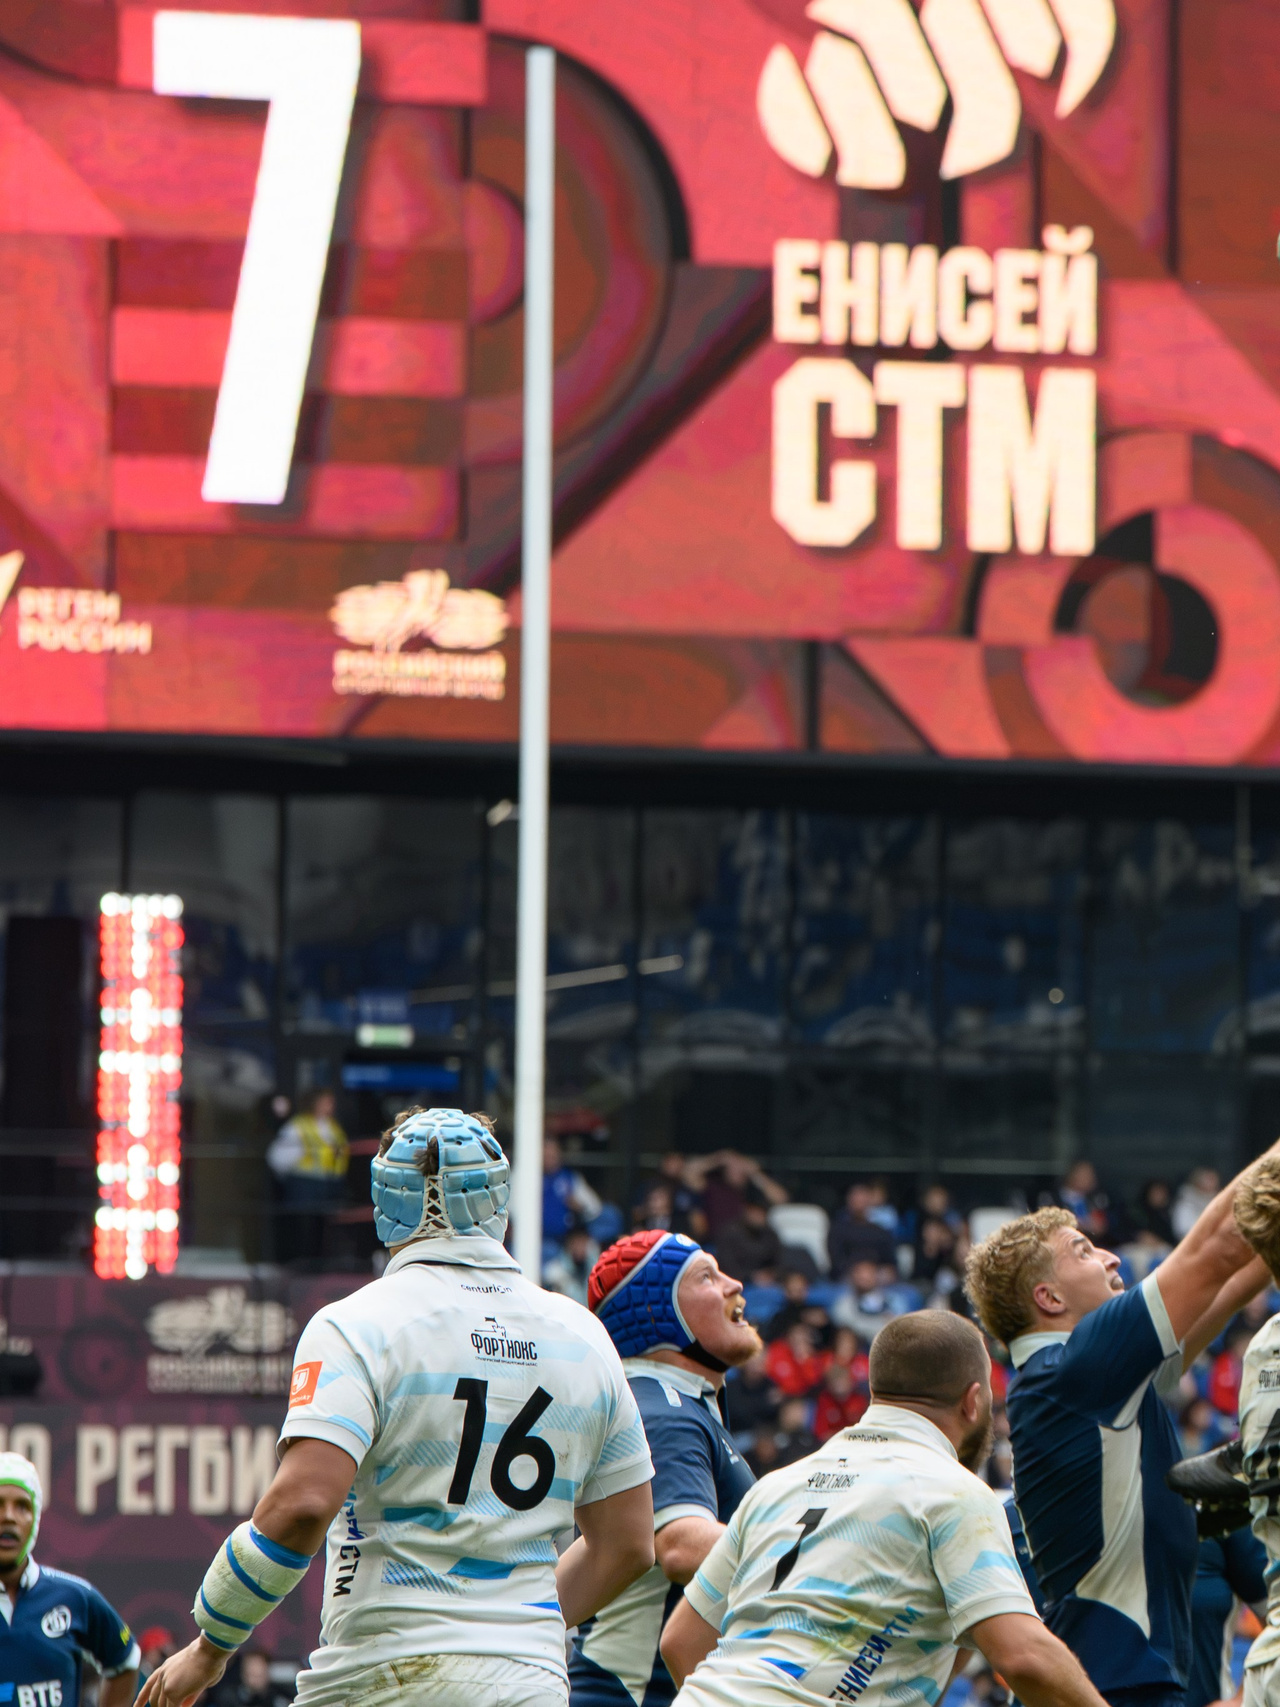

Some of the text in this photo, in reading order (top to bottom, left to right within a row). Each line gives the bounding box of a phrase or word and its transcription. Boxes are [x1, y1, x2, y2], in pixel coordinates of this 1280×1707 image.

[152, 10, 361, 504] 7
[773, 224, 1097, 355] ЕНИСЕЙ
[771, 357, 1097, 556] СТМ
[470, 1333, 538, 1361] ФОРТНОКС
[75, 1423, 277, 1516] РЕГБИ
[447, 1377, 556, 1511] 16
[333, 1545, 361, 1597] СТМ
[768, 1507, 828, 1592] 1
[17, 1680, 62, 1707] ВТБ
